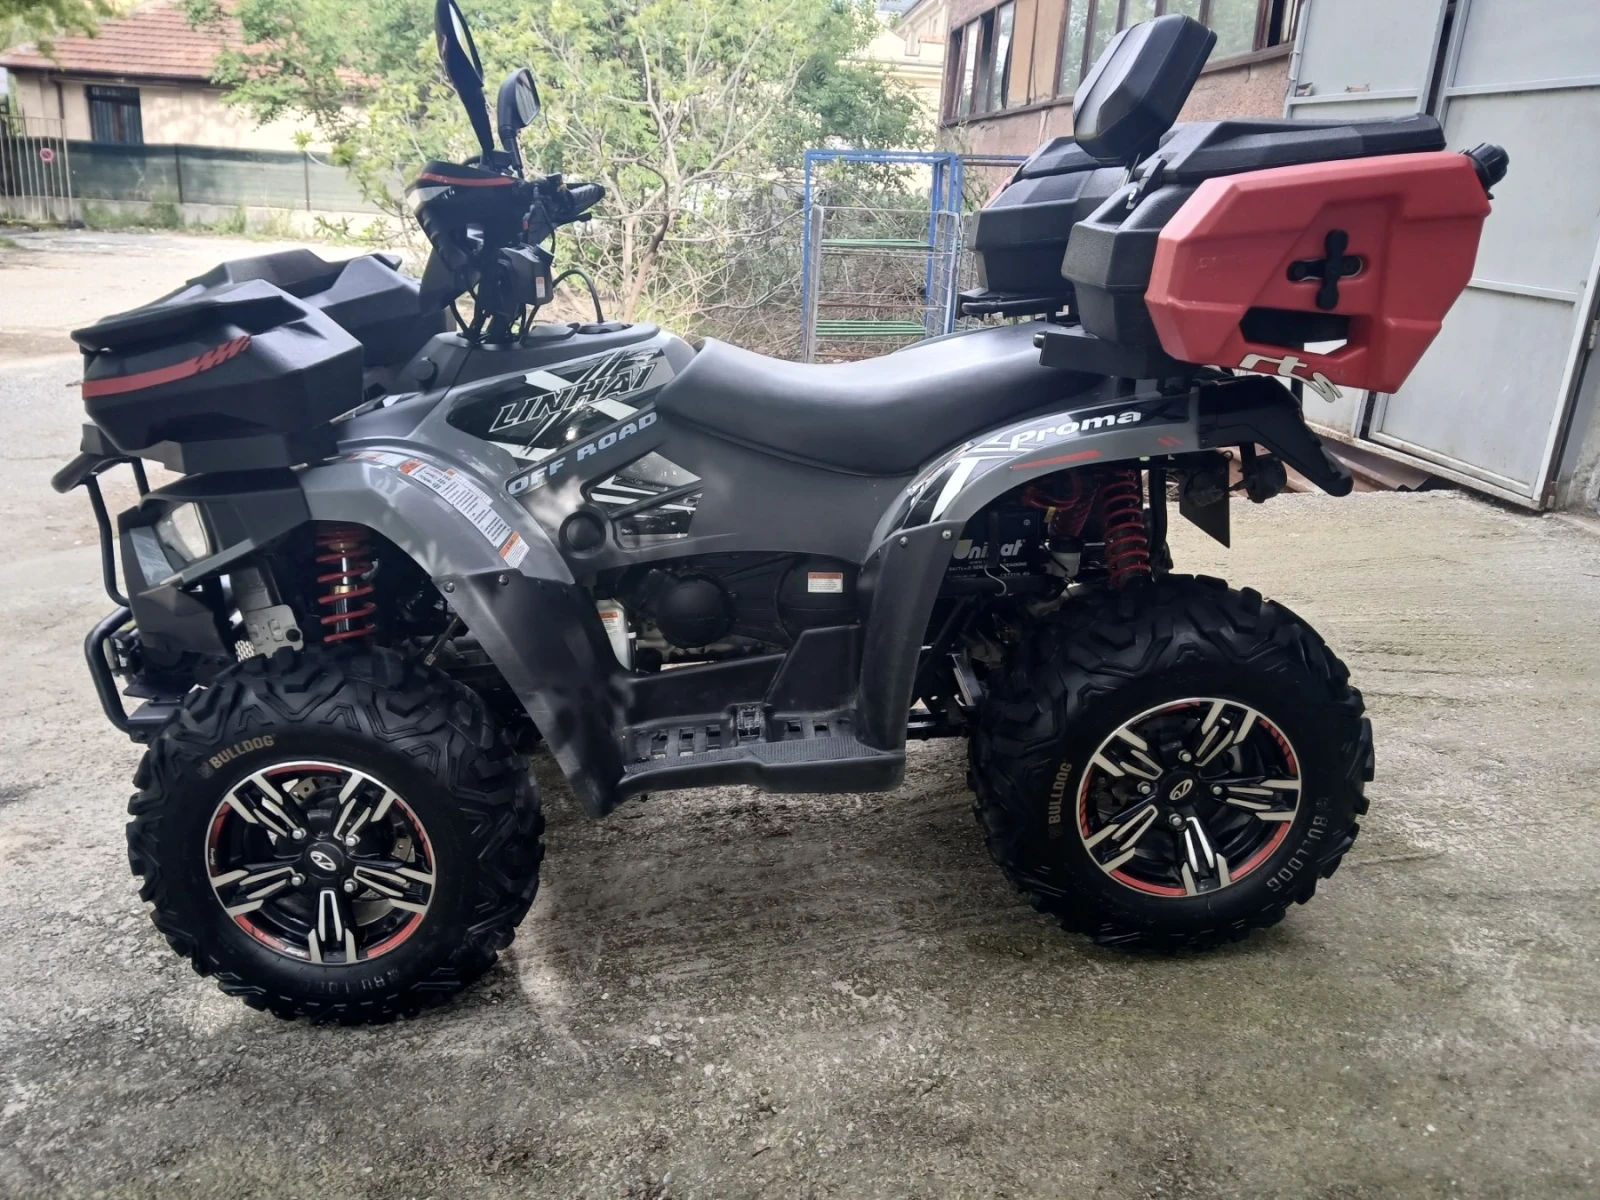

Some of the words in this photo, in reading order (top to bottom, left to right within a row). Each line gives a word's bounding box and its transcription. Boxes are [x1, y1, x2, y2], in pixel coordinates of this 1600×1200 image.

[489, 364, 658, 433] LINHAI
[508, 457, 566, 496] OFF
[577, 412, 658, 461] ROAD
[953, 539, 1023, 560] Uniat
[208, 734, 275, 769] BULLDOG
[1048, 762, 1073, 825] BULLDOG
